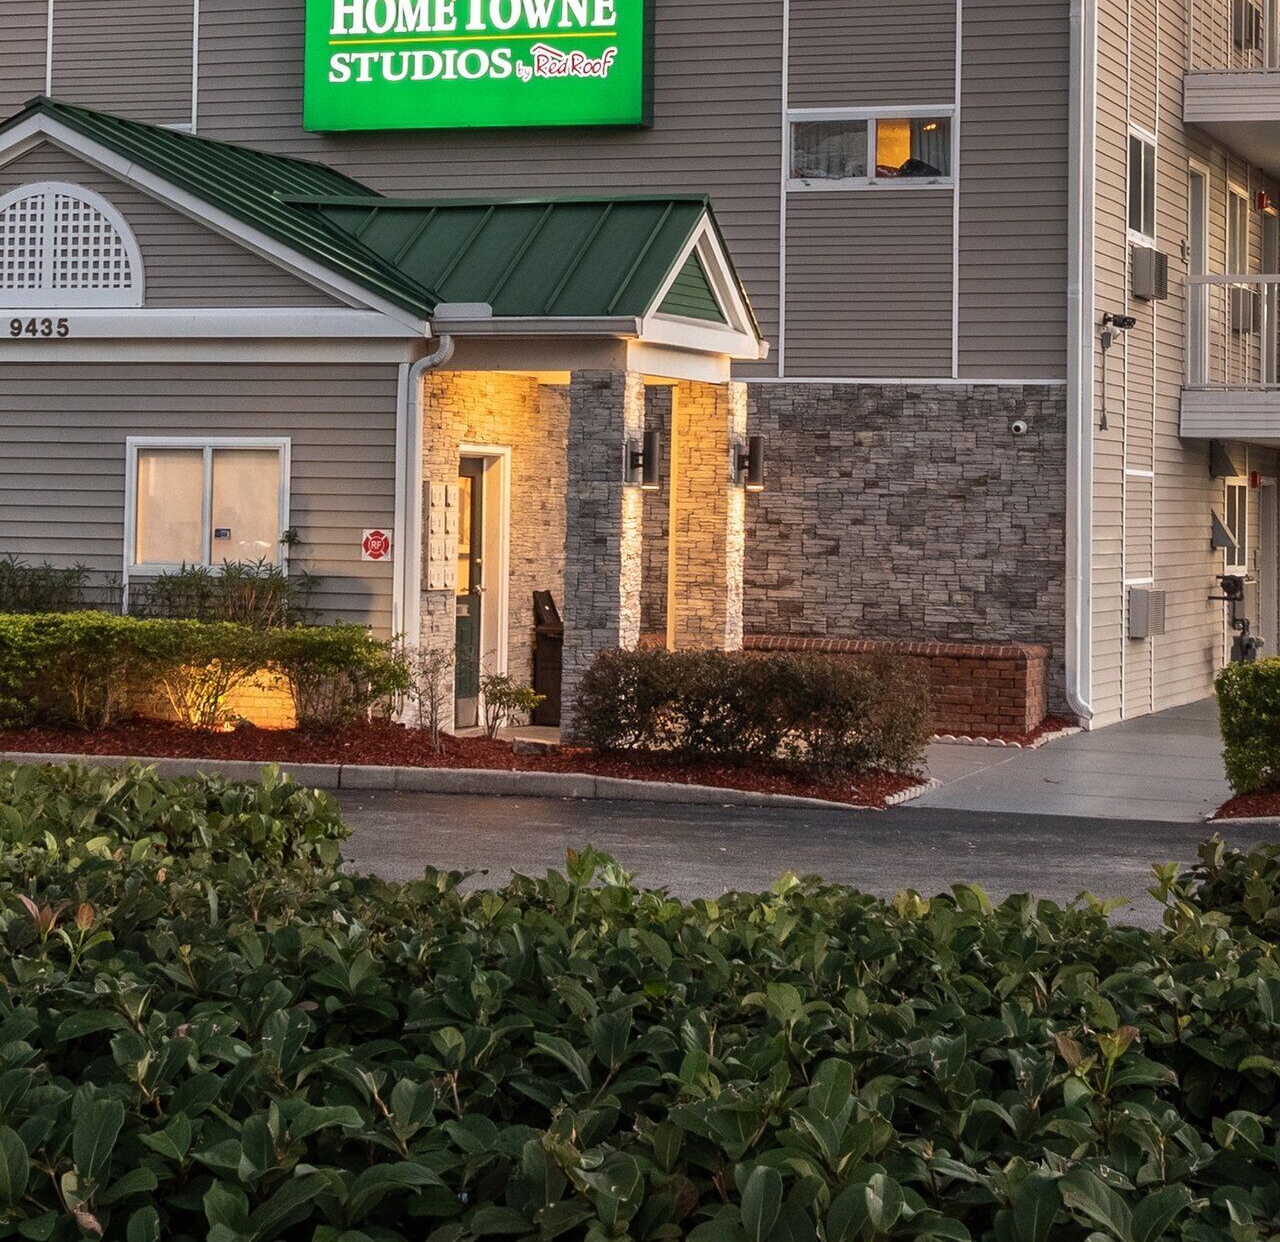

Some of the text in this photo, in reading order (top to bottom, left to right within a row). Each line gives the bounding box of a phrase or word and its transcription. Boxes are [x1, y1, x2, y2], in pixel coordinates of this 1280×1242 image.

[328, 48, 512, 83] STUDIOS
[517, 61, 532, 81] by
[9, 317, 70, 337] 9435
[370, 540, 383, 550] RF
